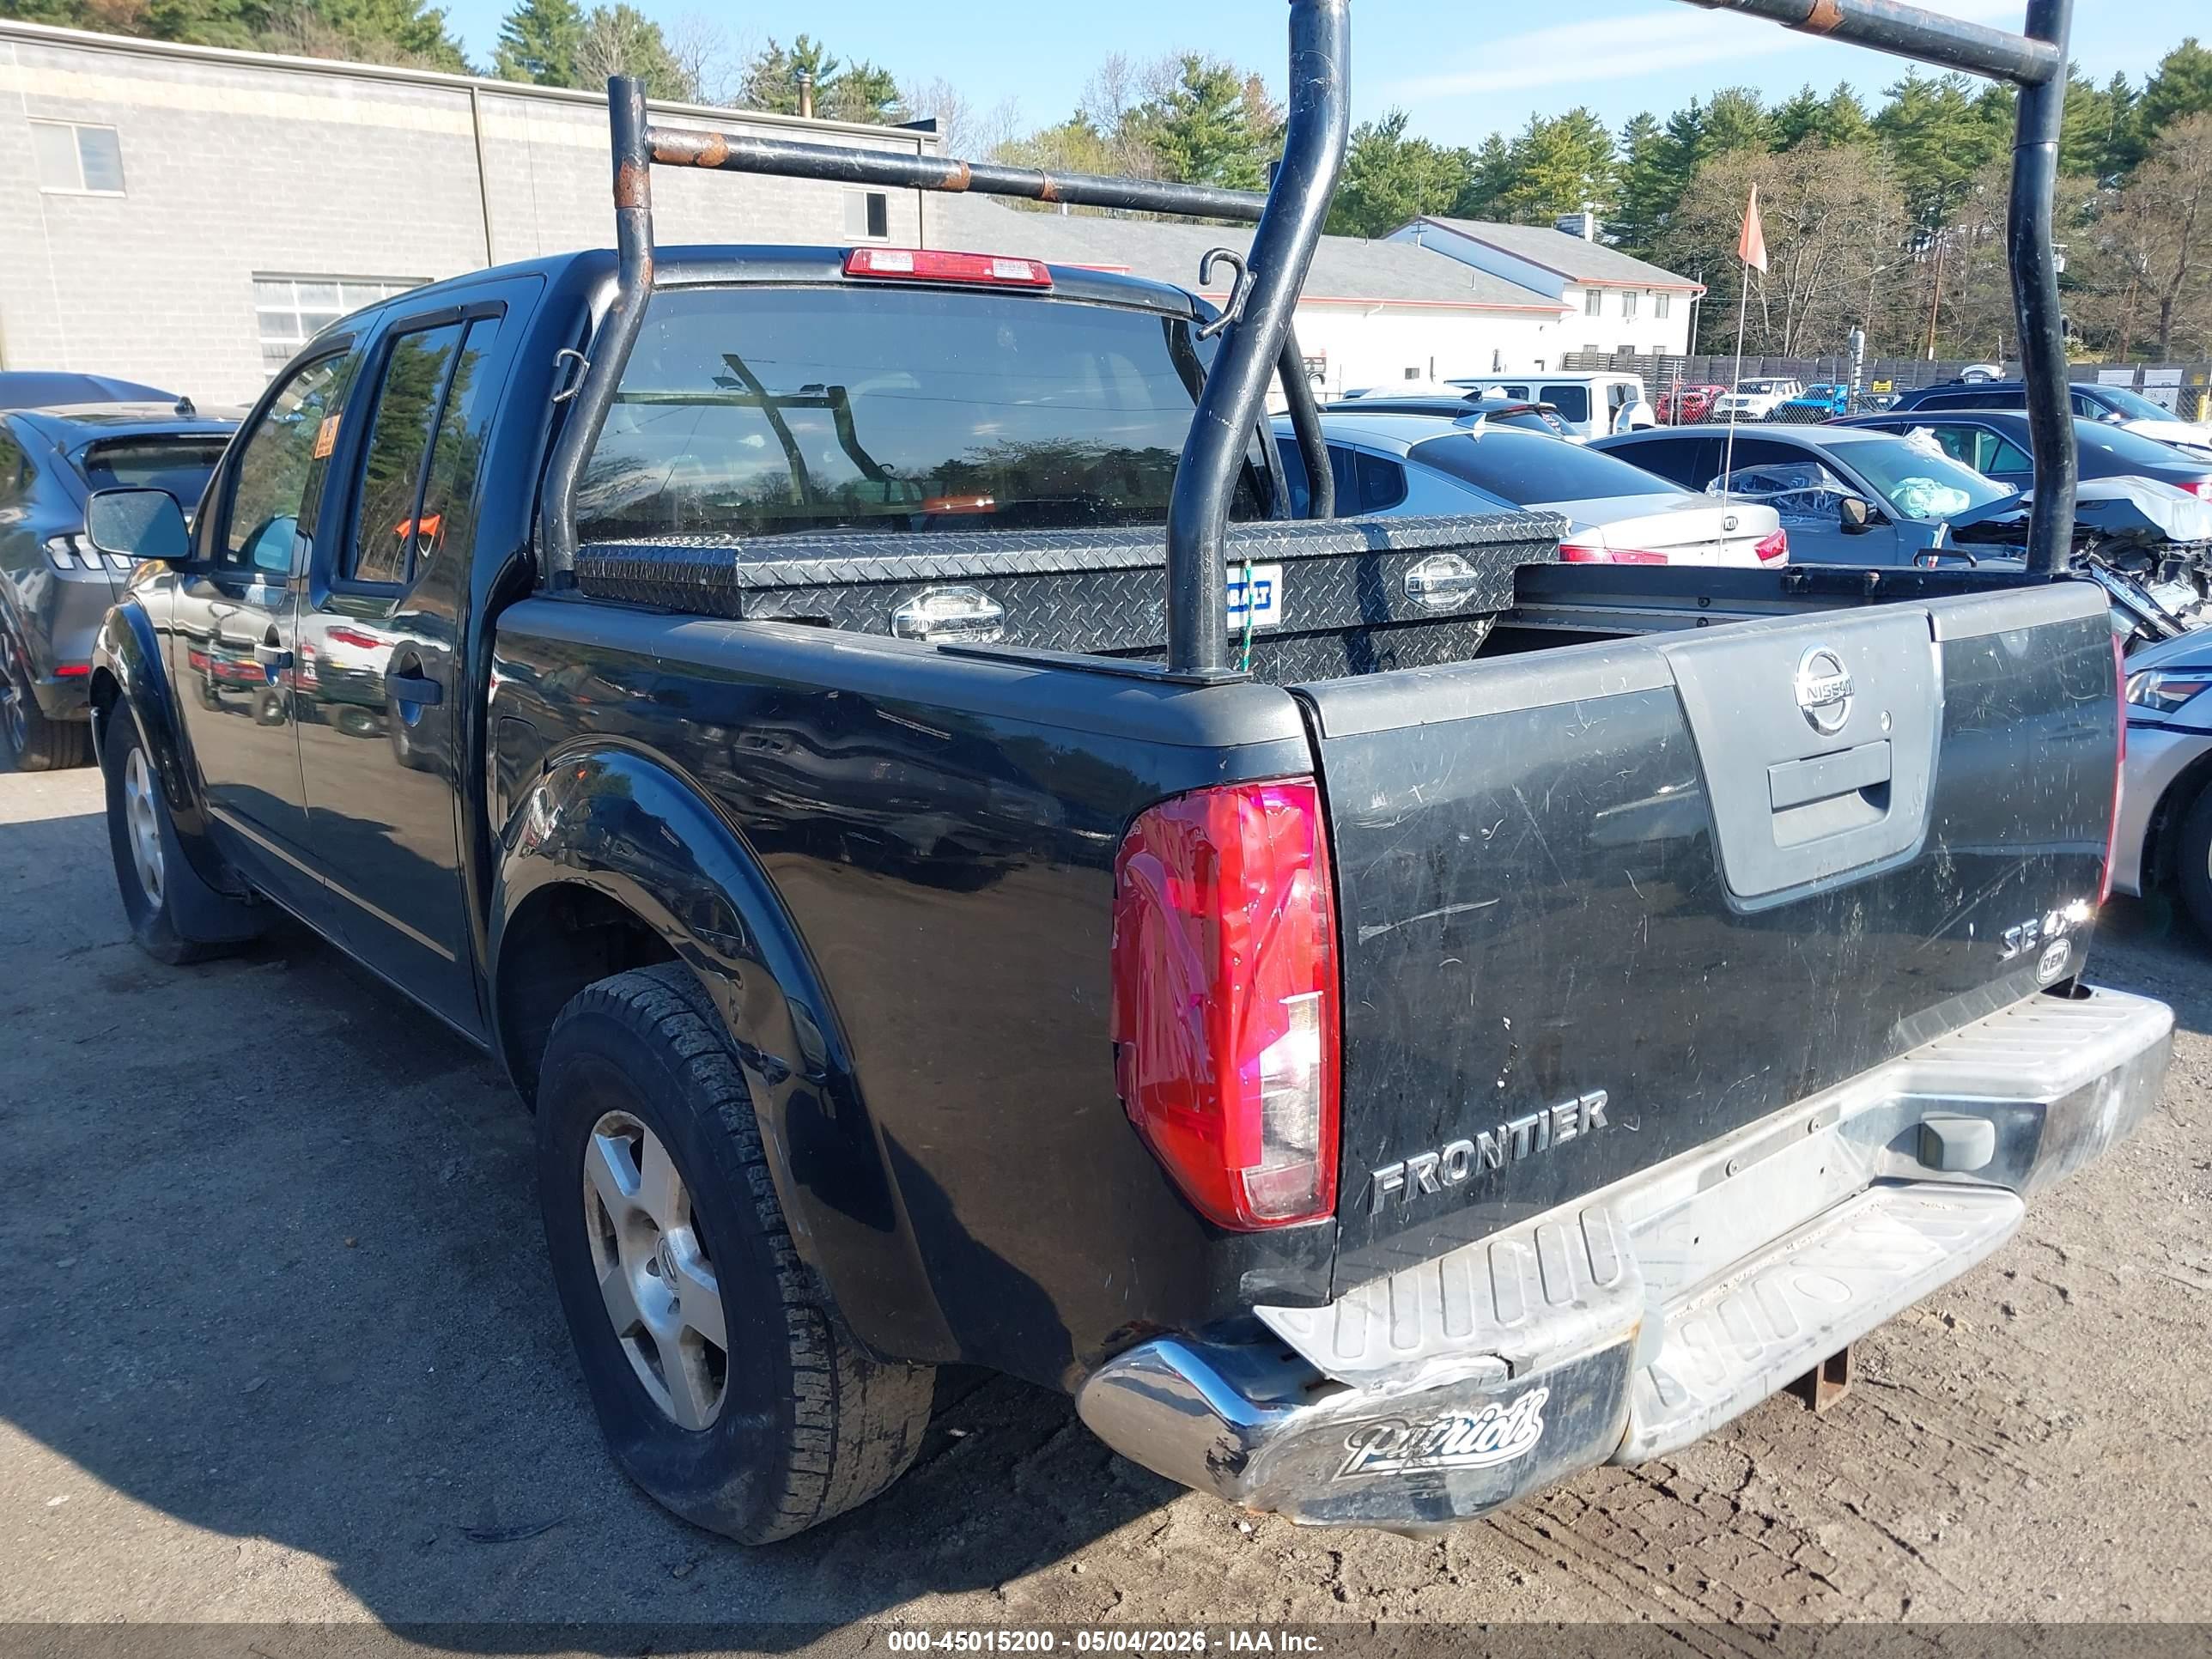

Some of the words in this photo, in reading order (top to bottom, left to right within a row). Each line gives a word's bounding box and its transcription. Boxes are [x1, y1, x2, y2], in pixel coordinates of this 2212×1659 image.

[1807, 678, 1852, 699] NISSAN
[1998, 919, 2038, 962] SE
[1370, 1089, 1609, 1215] FRONTIER
